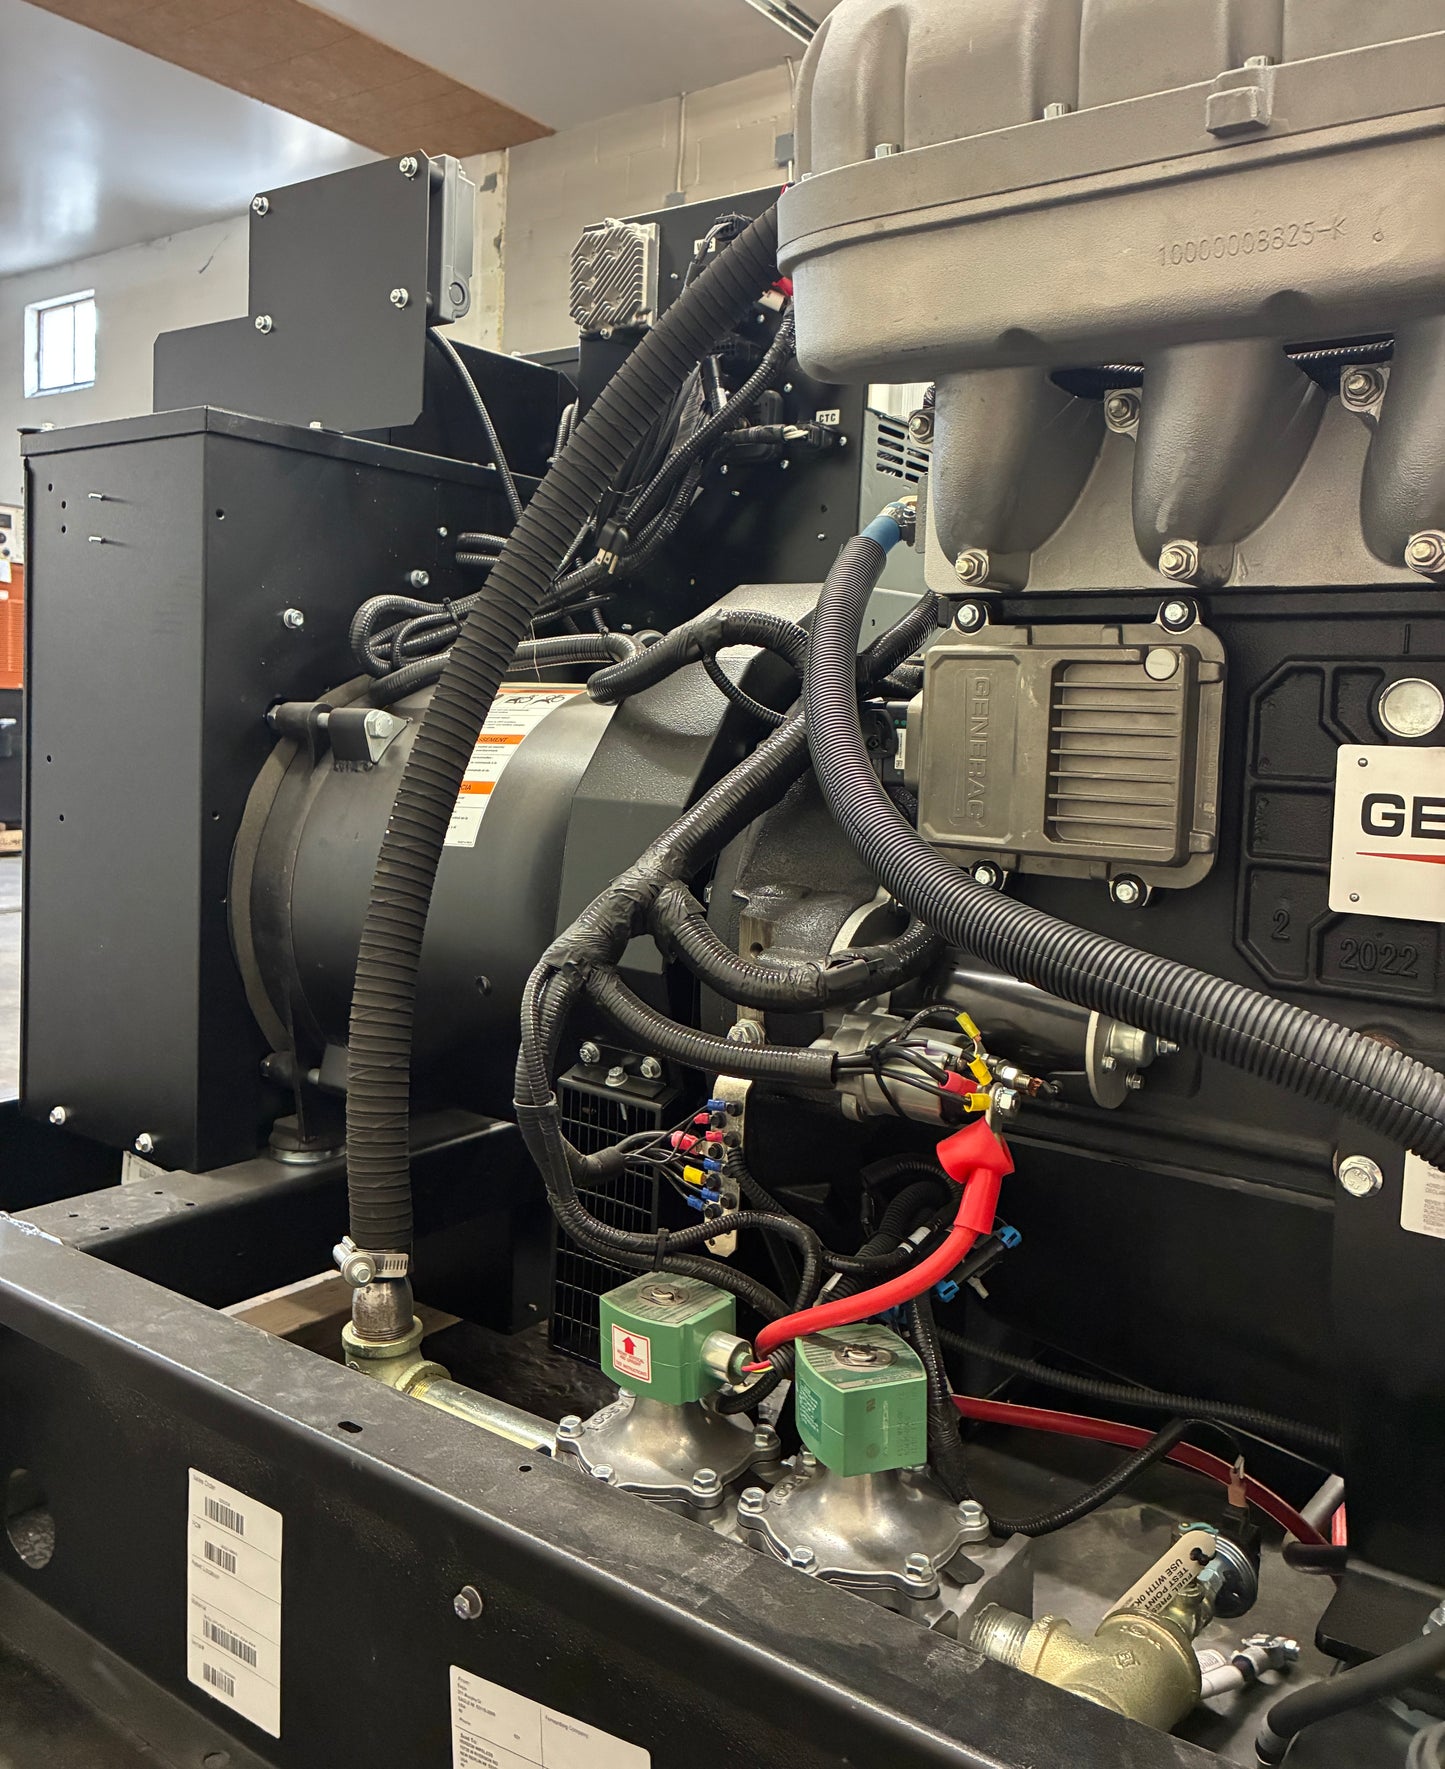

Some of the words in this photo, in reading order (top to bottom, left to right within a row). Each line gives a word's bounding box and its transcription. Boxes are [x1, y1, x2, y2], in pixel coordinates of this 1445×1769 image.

[819, 413, 837, 423] CTC
[966, 676, 990, 824] GENERAC
[1271, 908, 1291, 941] 2
[1338, 937, 1419, 979] 2022
[1166, 1558, 1183, 1577] USE
[1168, 1567, 1189, 1587] TEST
[1144, 1575, 1168, 1598] WITH
[1171, 1573, 1193, 1593] FUEL
[1144, 1586, 1169, 1610] POINT
